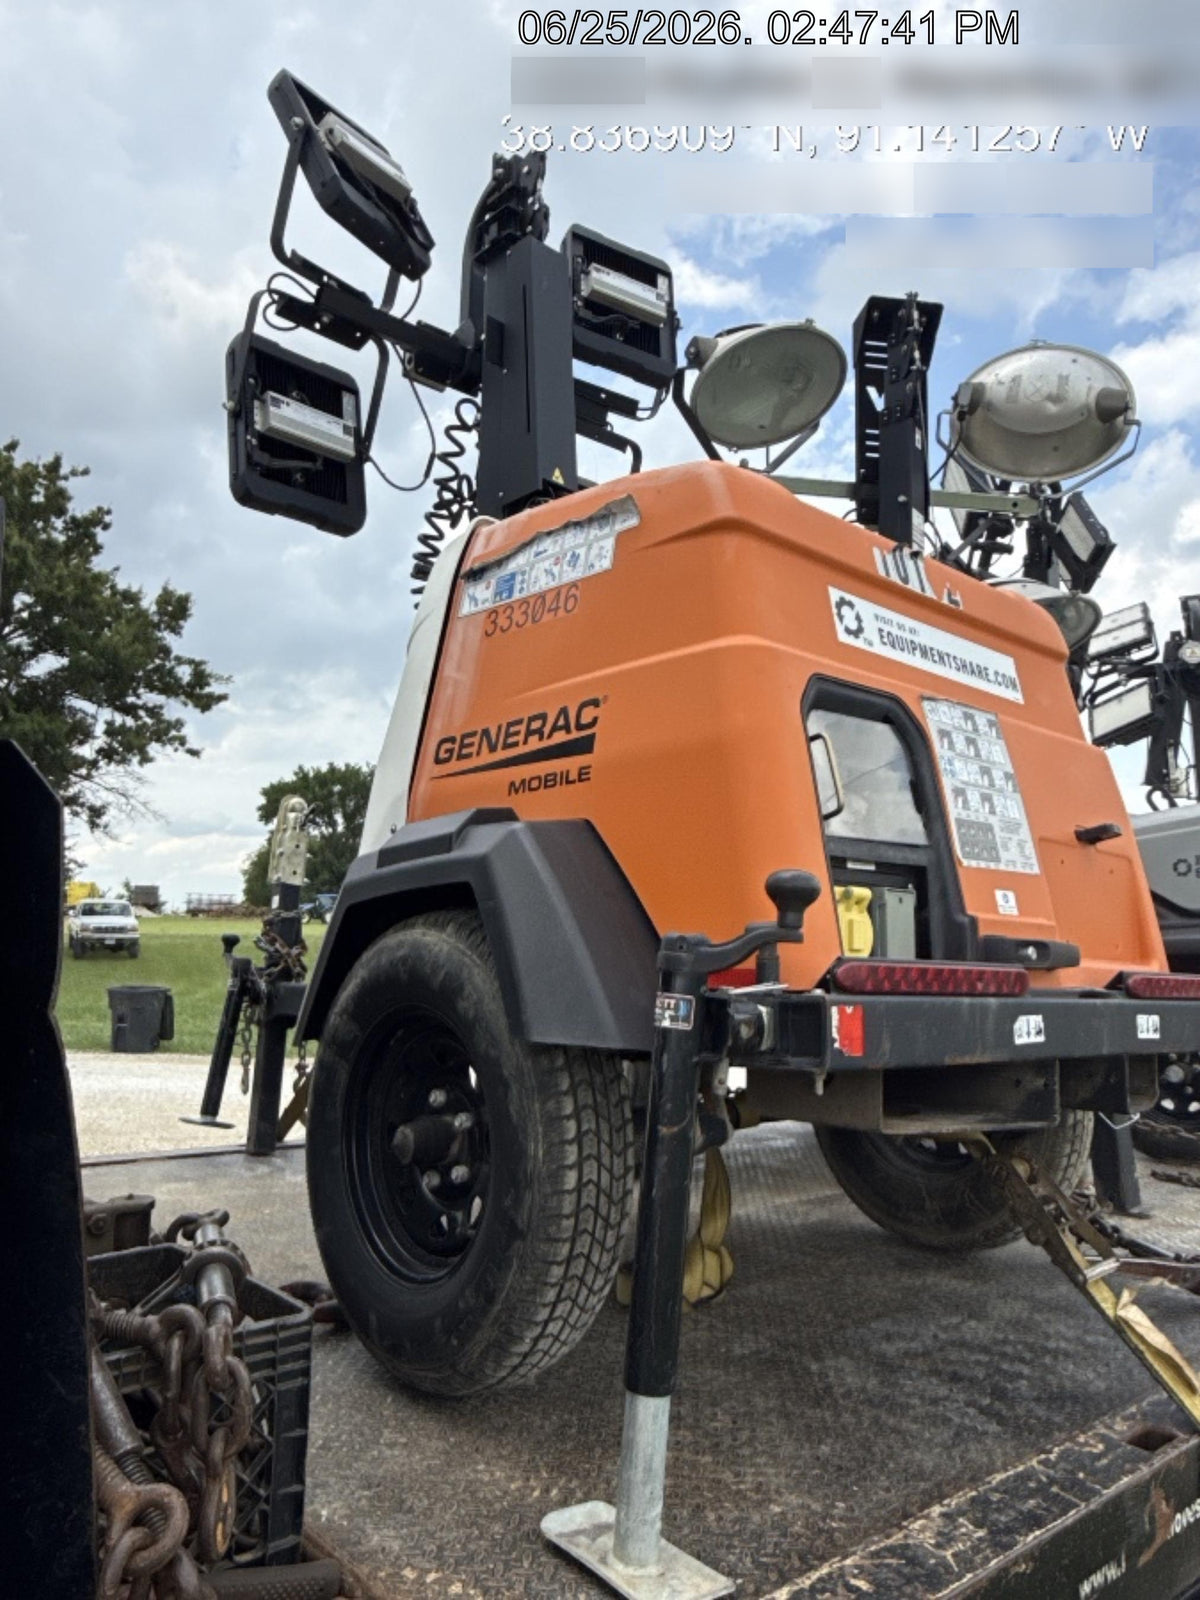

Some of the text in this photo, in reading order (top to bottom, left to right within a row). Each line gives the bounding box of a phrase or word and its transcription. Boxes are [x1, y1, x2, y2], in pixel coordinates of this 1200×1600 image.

[484, 584, 579, 638] 333046
[877, 628, 1020, 694] EQUIPMENTSHARE.COM
[433, 698, 602, 766] GENERAC
[507, 765, 592, 798] MOBILE
